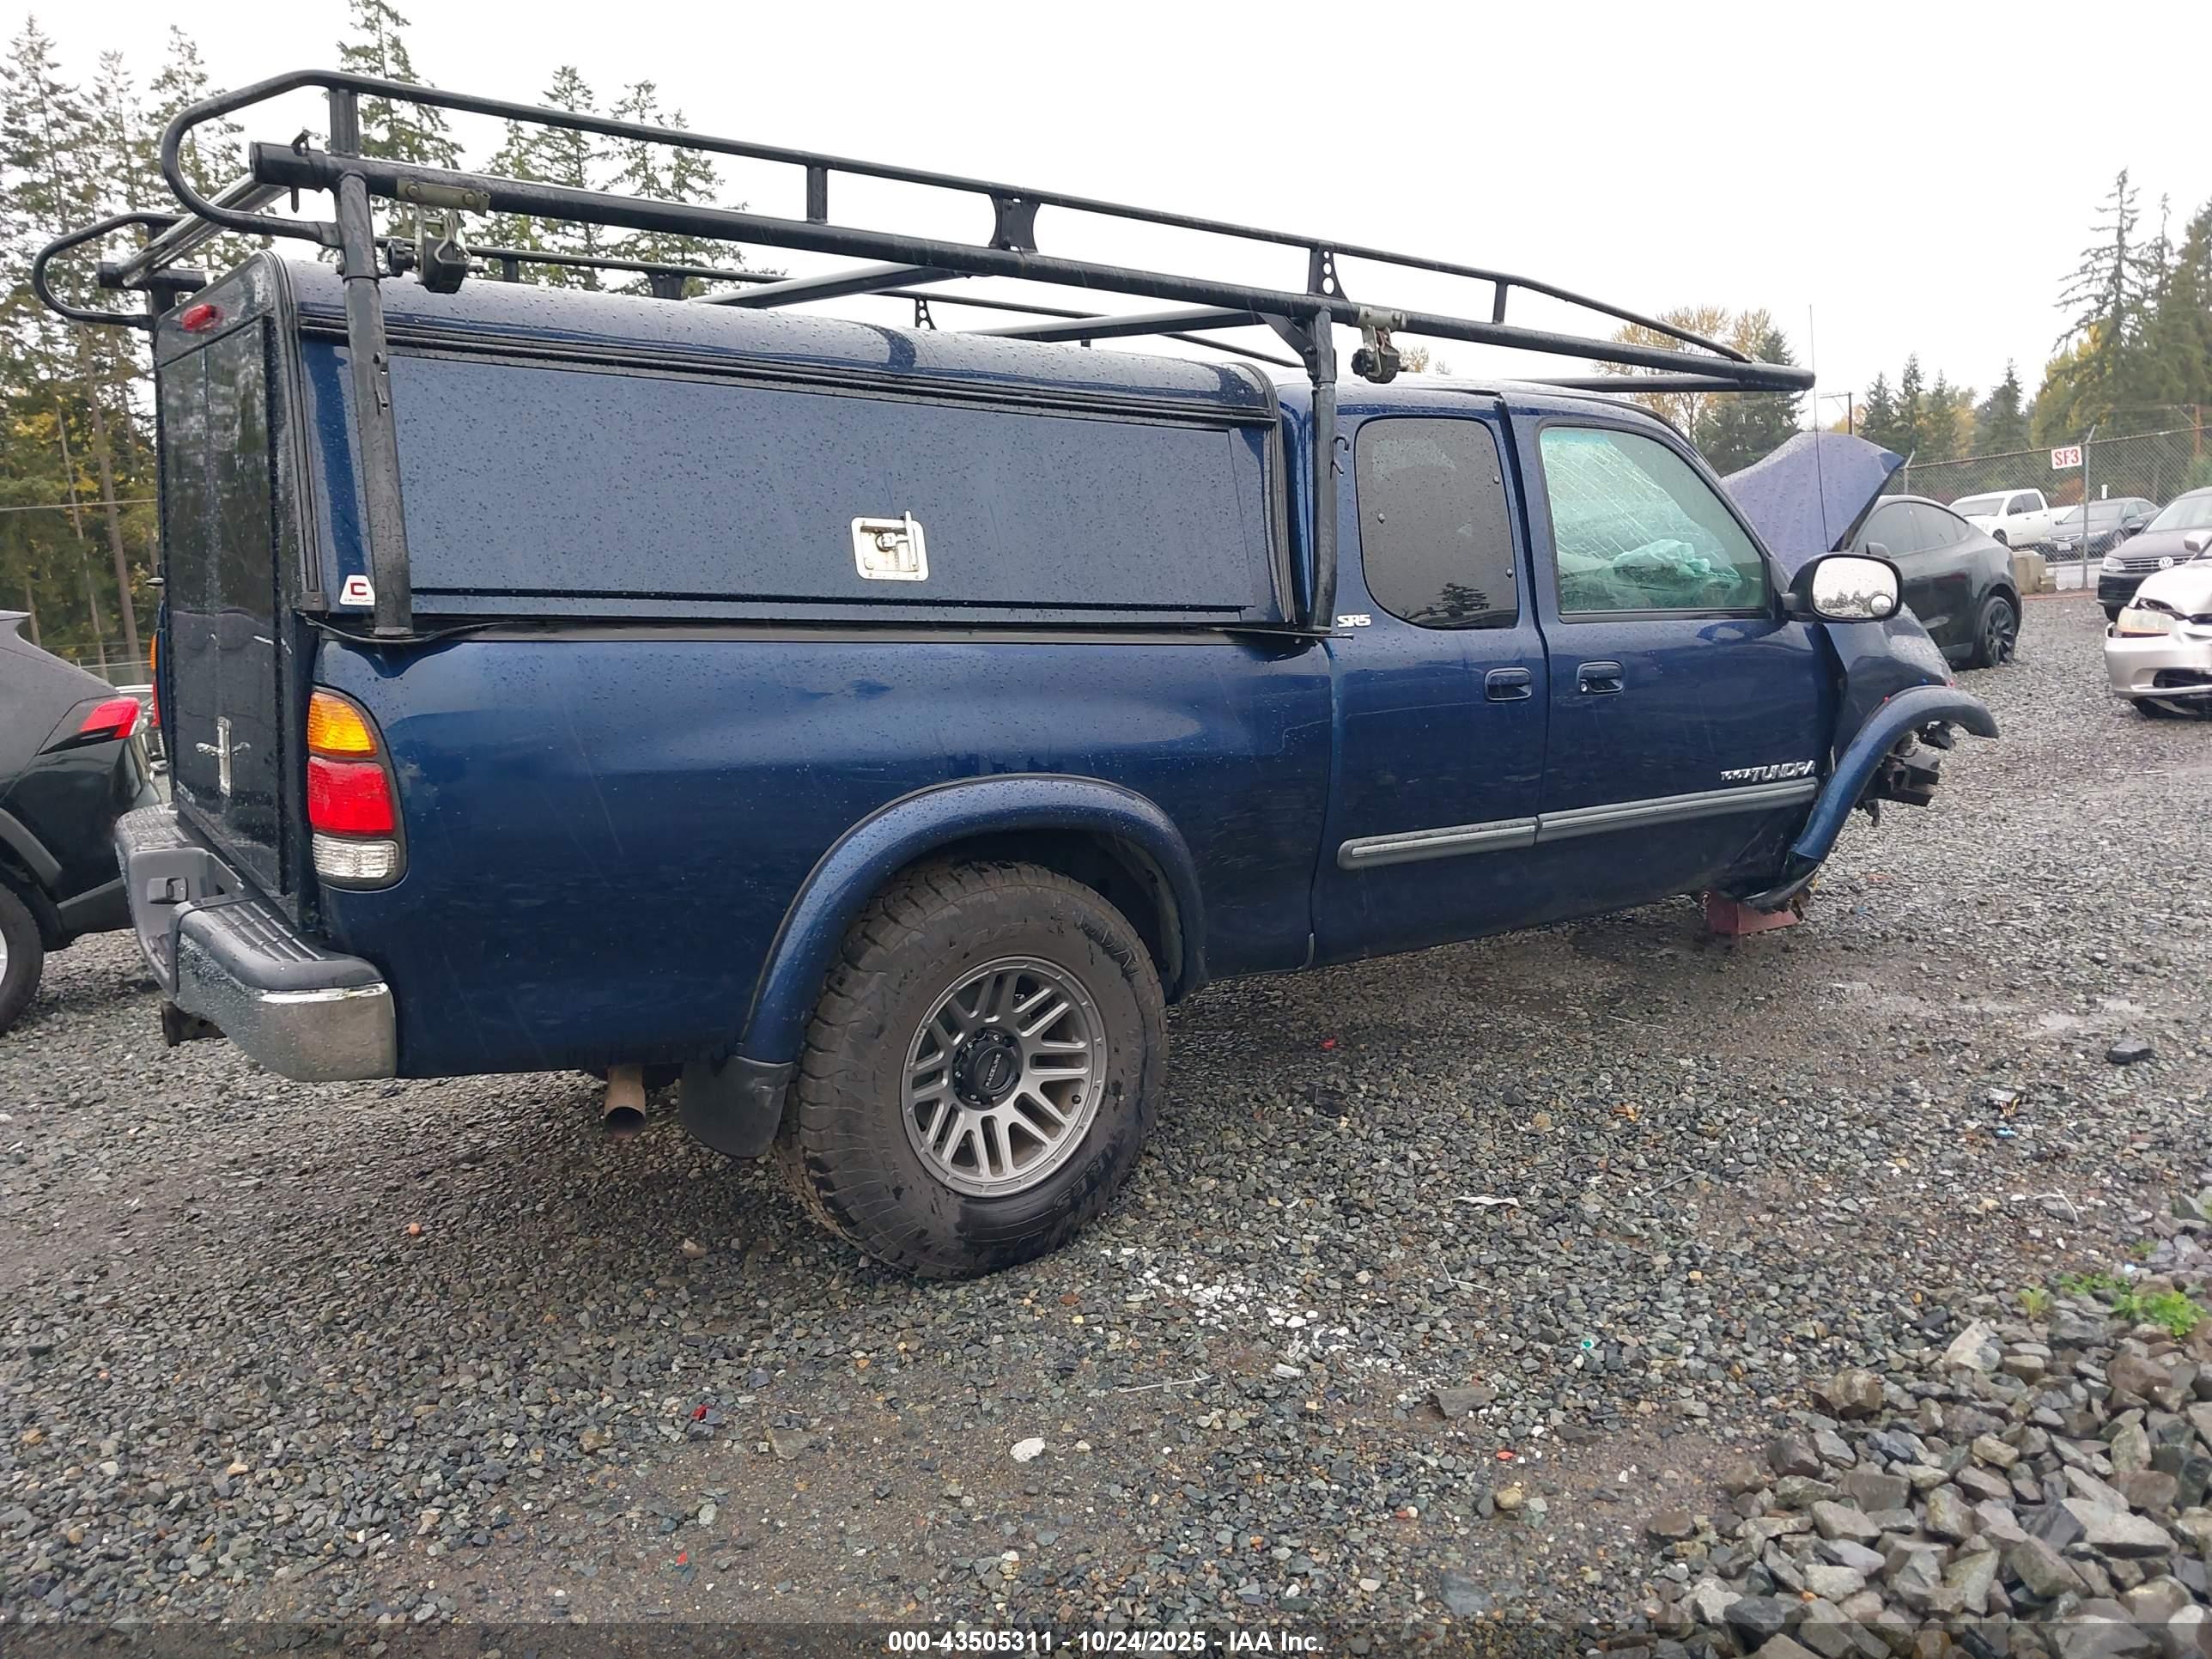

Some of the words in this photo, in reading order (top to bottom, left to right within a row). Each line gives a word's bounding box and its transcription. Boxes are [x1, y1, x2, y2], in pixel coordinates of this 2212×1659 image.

[2054, 448, 2079, 466] SF3
[1337, 614, 1371, 628] SR5
[1751, 759, 1816, 782] TUNDRA
